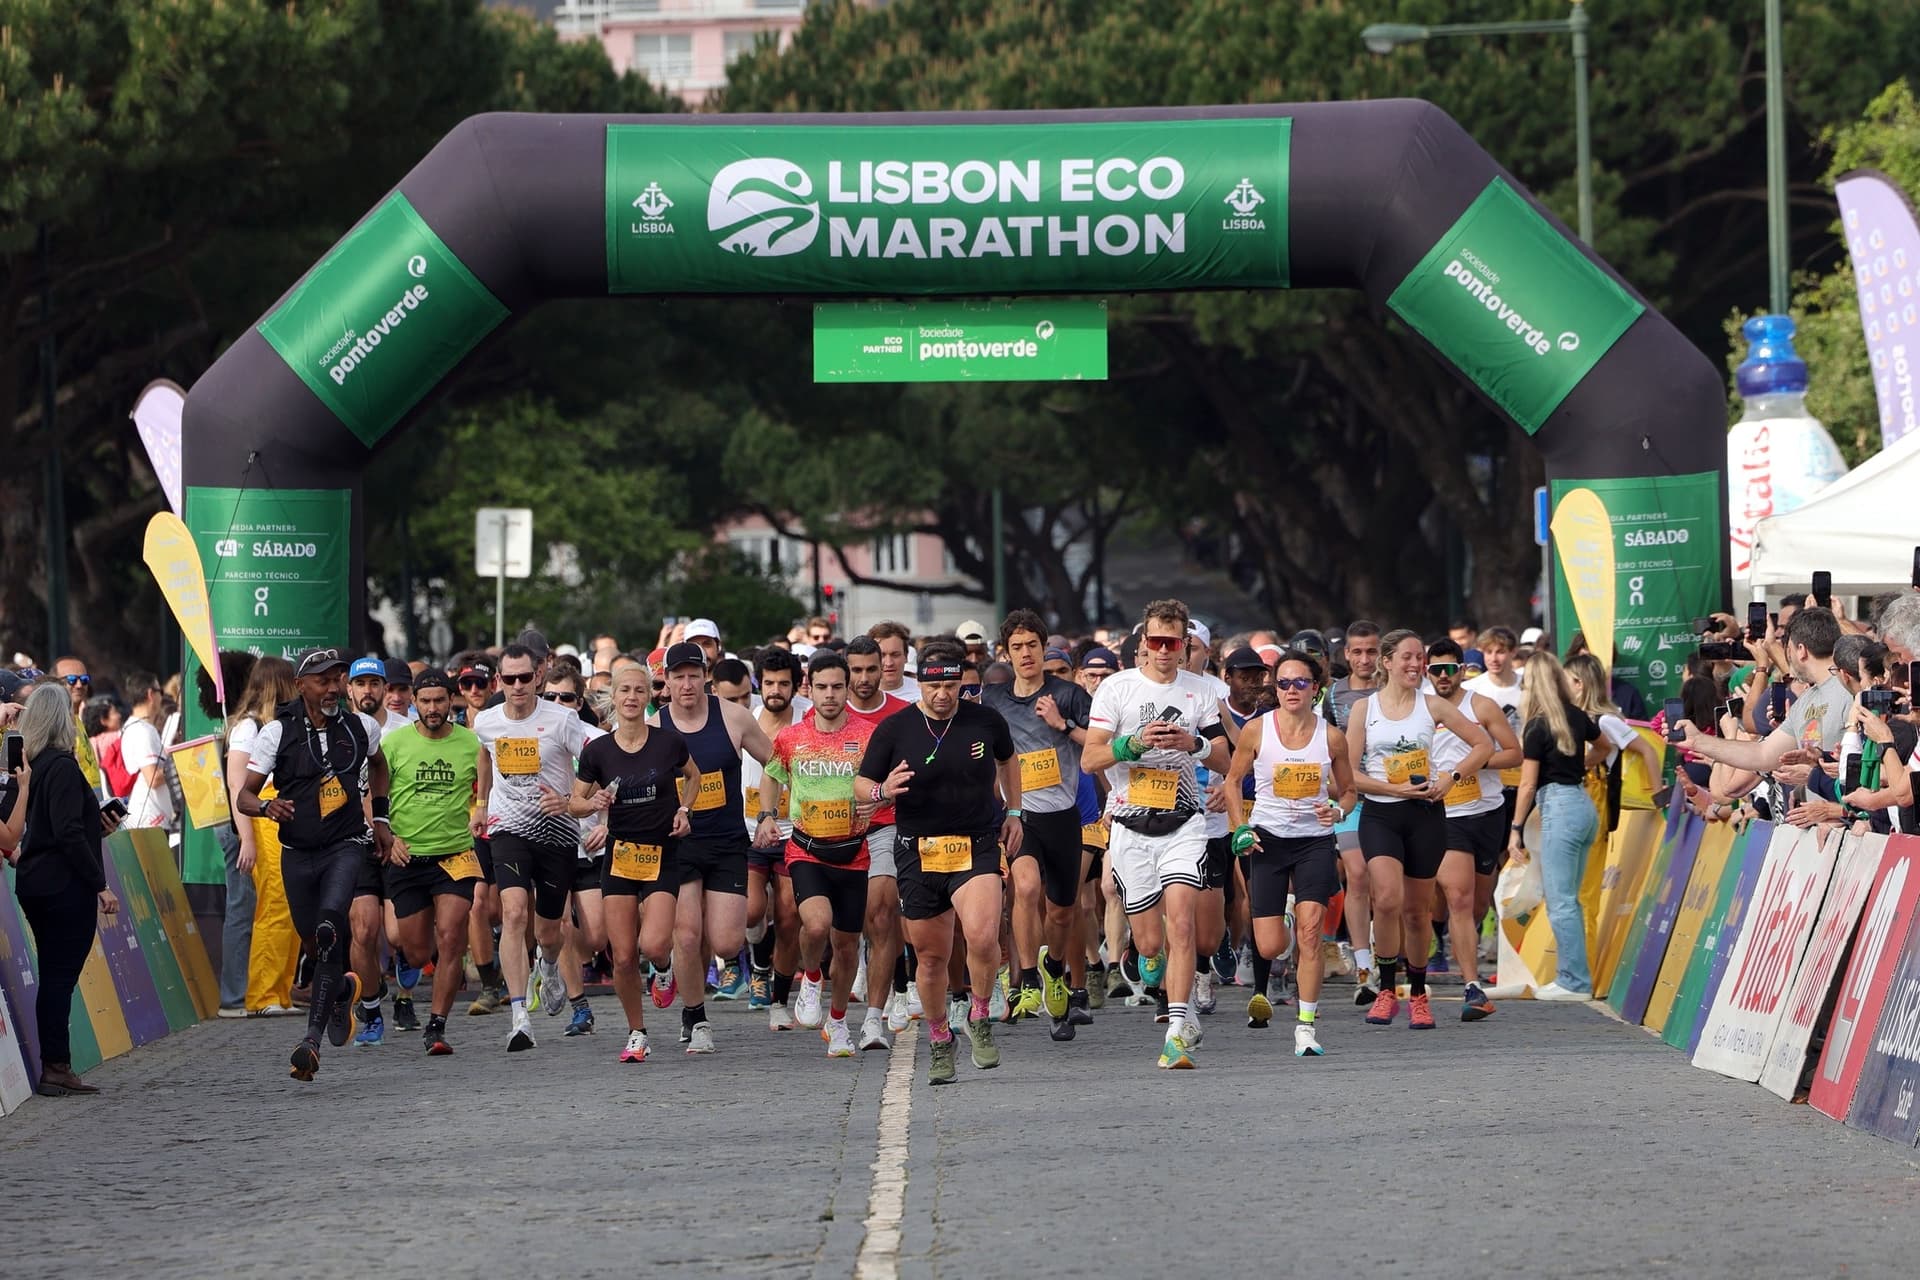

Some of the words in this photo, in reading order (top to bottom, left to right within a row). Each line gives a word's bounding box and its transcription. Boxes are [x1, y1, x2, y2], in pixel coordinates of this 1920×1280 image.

[829, 160, 1040, 204] LISBON
[1061, 156, 1185, 201] ECO
[632, 222, 675, 234] LISBOA
[1222, 219, 1266, 230] LISBOA
[829, 213, 1185, 258] MARATHON
[1459, 247, 1502, 286] sociedade
[1443, 259, 1551, 356] pontoverde
[330, 284, 429, 385] pontoverde
[884, 336, 903, 344] ECO
[318, 329, 357, 368] sociedade
[863, 345, 903, 353] PARTNER
[919, 339, 1038, 361] pontoverde
[256, 524, 297, 532] PARTNERS
[1624, 529, 1689, 547] SÁBADO
[252, 540, 317, 558] SÁBADO
[224, 571, 262, 580] PARCEIRO
[265, 571, 300, 580] TÉCNICO
[222, 627, 265, 636] PARCEIROS
[266, 627, 301, 636] OFICIAIS
[513, 746, 537, 757] 1129
[798, 761, 854, 776] KENYA
[1031, 758, 1056, 771] 1637
[1405, 757, 1427, 770] 1667
[417, 771, 454, 781] TRAIL
[1294, 772, 1320, 782] 1735
[1150, 779, 1175, 791] 1737
[822, 809, 848, 820] 1046
[943, 843, 968, 854] 1071
[633, 854, 659, 864] 1699
[1728, 839, 1818, 1015] Vitalis
